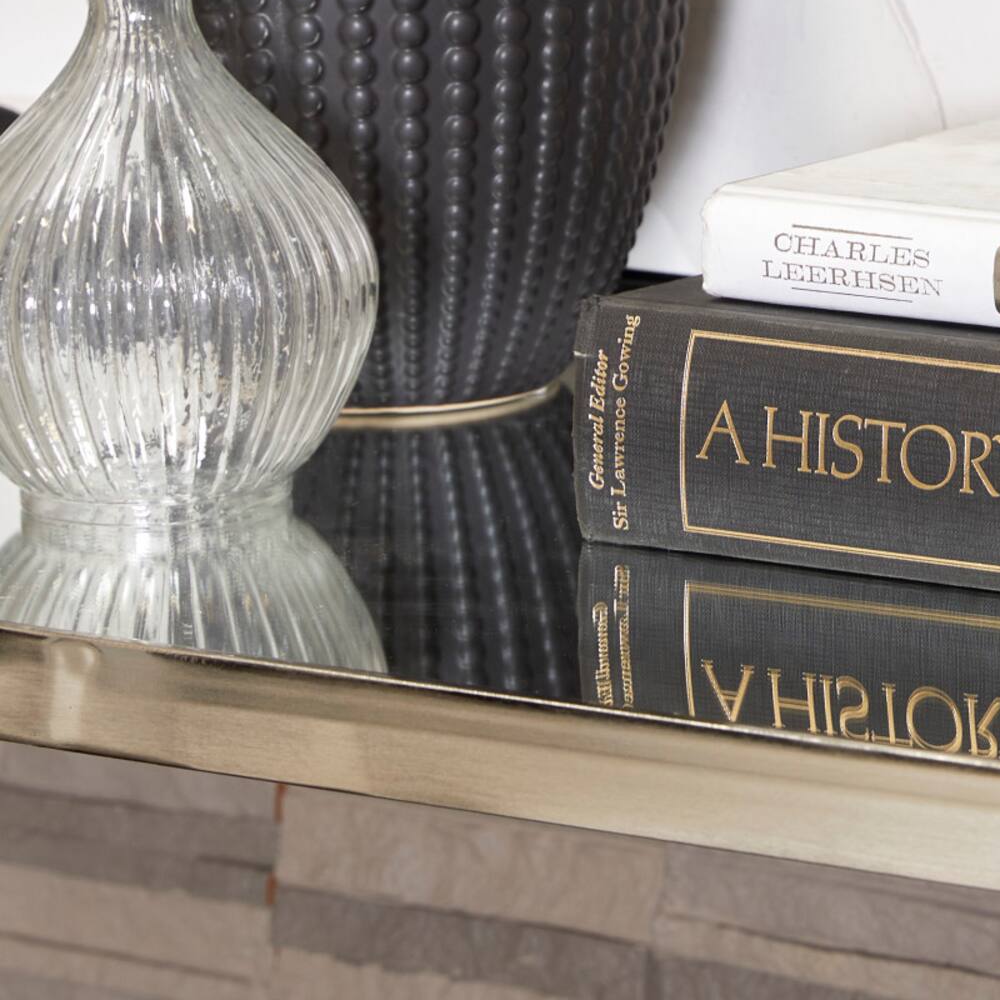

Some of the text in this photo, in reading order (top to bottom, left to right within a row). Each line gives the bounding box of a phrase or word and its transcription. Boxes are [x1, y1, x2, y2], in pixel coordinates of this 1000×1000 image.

[762, 259, 944, 296] LEERHSEN
[774, 232, 931, 268] CHARLES
[588, 349, 609, 490] General Editor
[611, 314, 641, 531] Sir Lawrence Gowing
[695, 400, 750, 465] A
